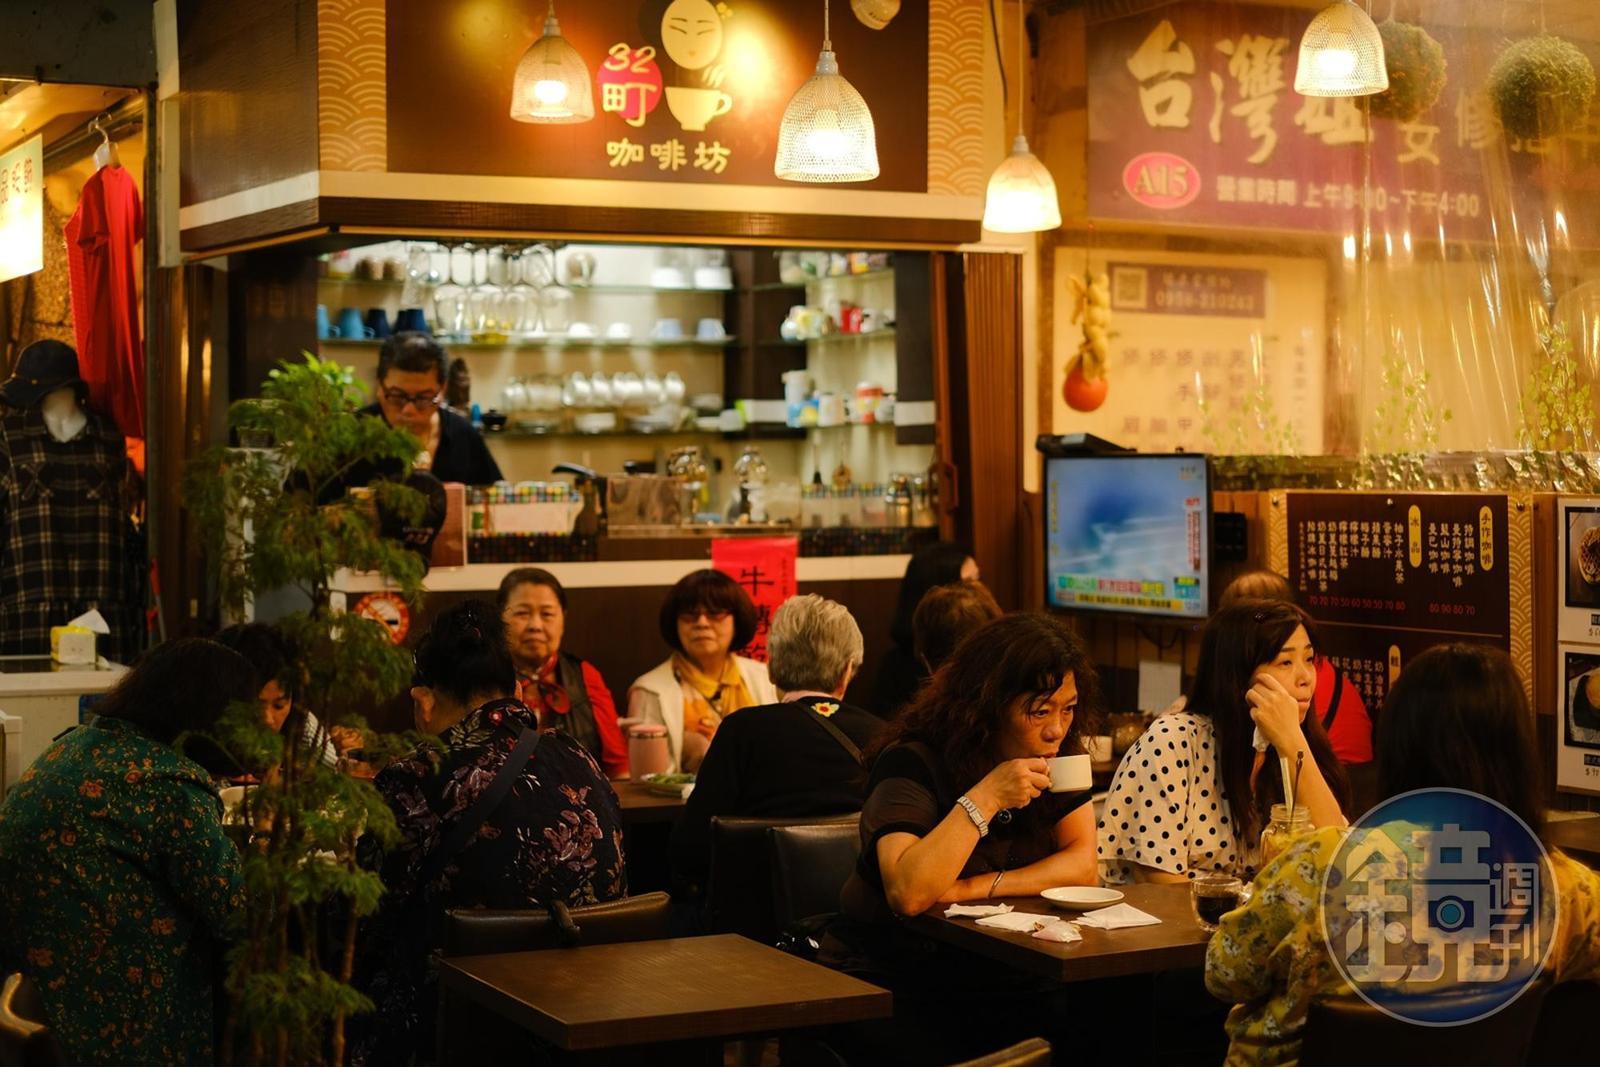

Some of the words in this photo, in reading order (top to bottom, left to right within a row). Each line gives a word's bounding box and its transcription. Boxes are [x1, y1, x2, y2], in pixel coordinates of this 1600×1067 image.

[604, 43, 657, 74] 32
[602, 82, 658, 128] 町
[606, 138, 732, 173] 咖啡坊
[1135, 165, 1189, 198] A15
[1216, 175, 1297, 207] 營業時間
